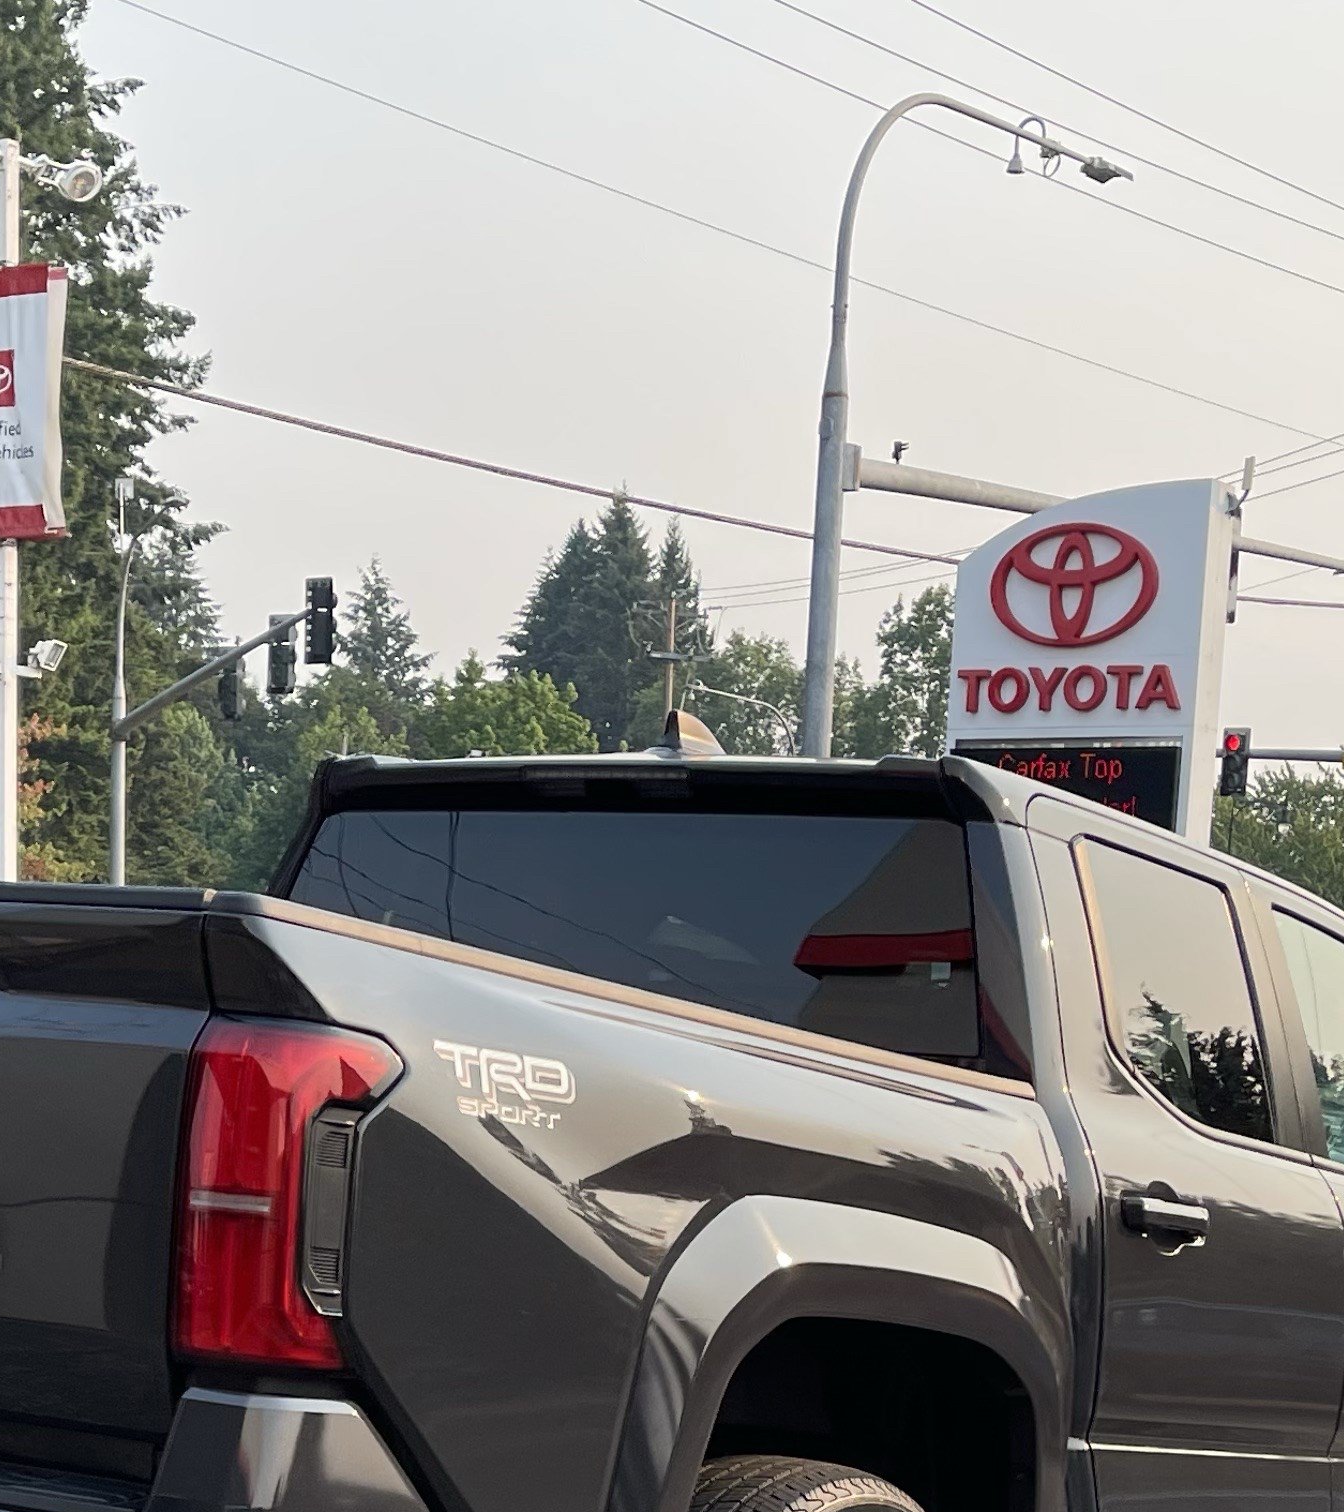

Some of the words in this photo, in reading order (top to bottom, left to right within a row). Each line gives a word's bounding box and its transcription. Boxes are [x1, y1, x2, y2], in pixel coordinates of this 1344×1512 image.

[957, 664, 1181, 714] TOYOTA
[997, 752, 1071, 779] Carfax
[1079, 753, 1124, 785] Top
[433, 1039, 577, 1105] TRD
[456, 1096, 562, 1130] SPORT
